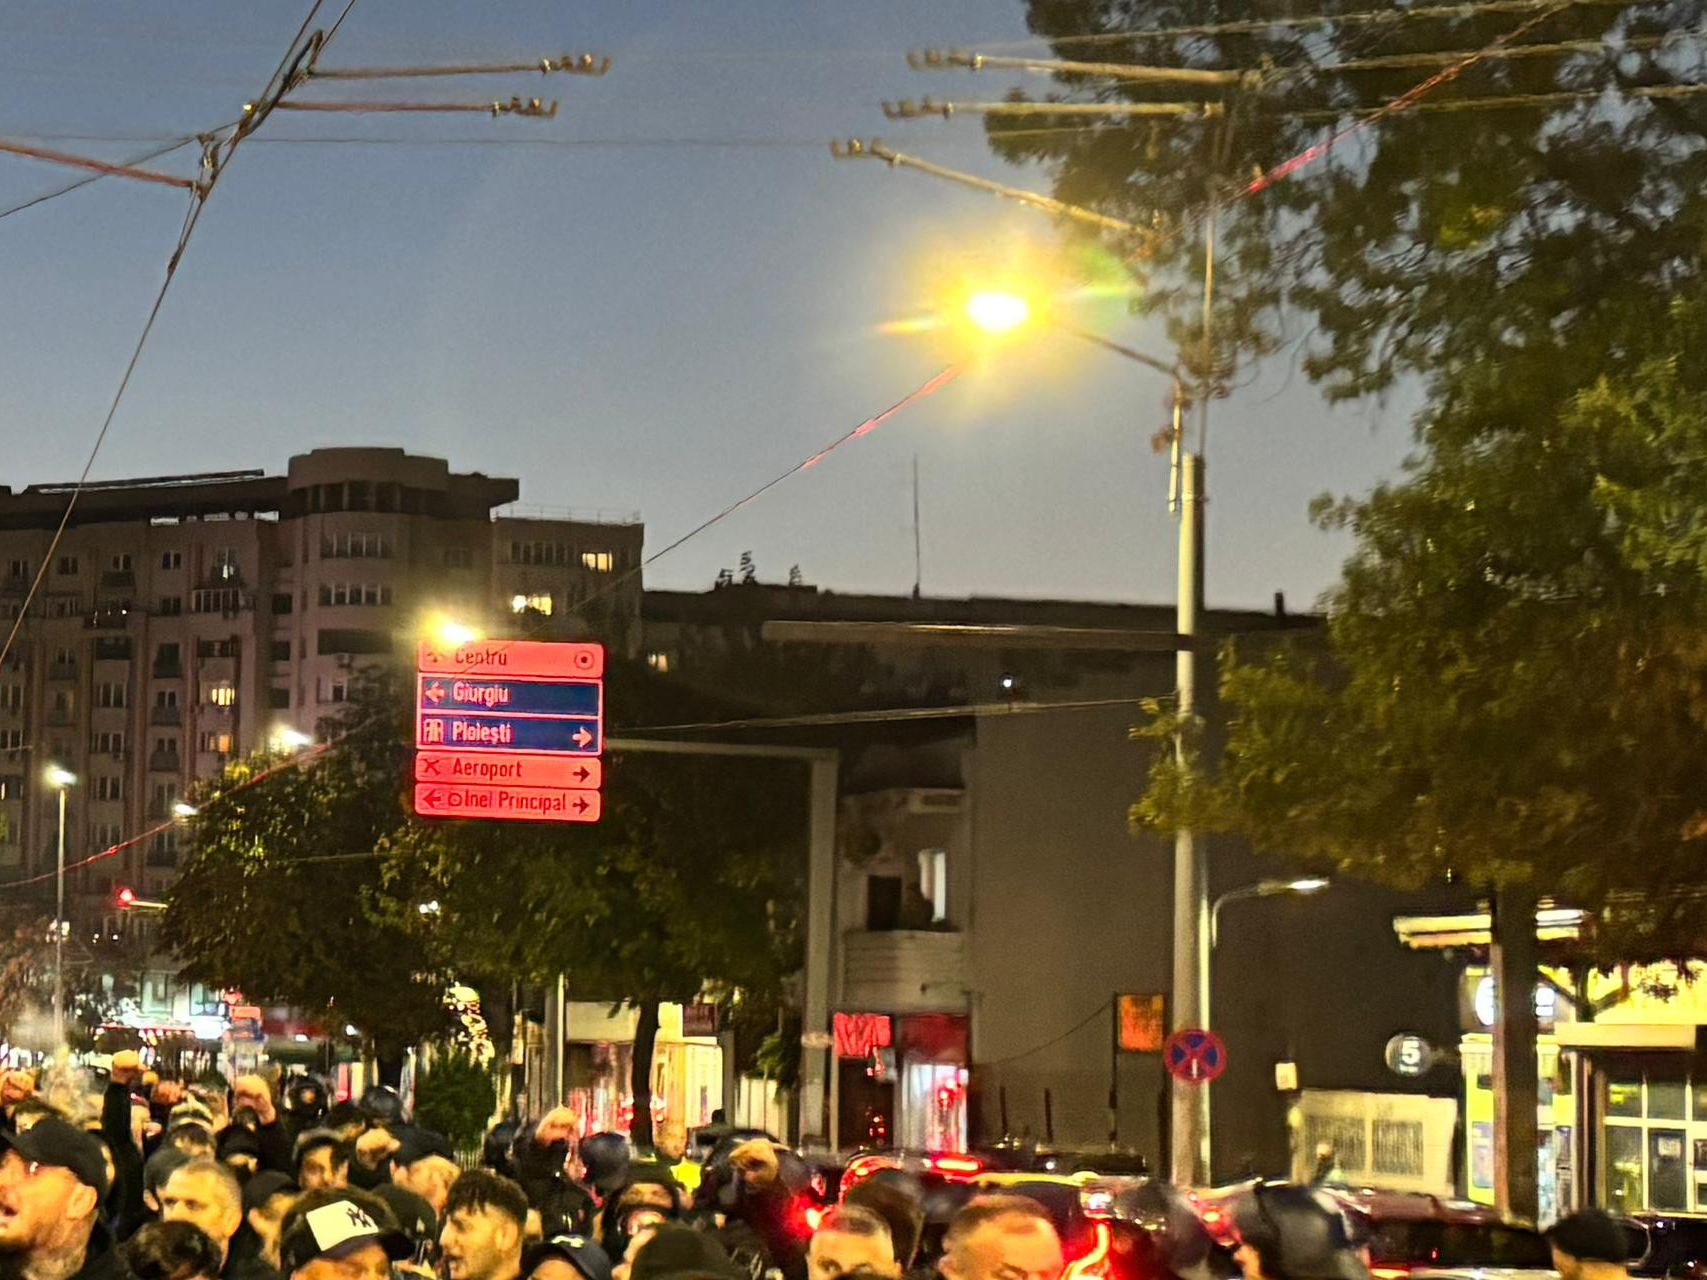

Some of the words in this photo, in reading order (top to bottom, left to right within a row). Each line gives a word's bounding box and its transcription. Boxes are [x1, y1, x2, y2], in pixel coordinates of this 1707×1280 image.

[455, 647, 507, 666] Centru
[453, 681, 509, 708] Giurgiu
[453, 757, 522, 781] Aeroport
[464, 789, 492, 807] Inel
[498, 790, 566, 815] Principal
